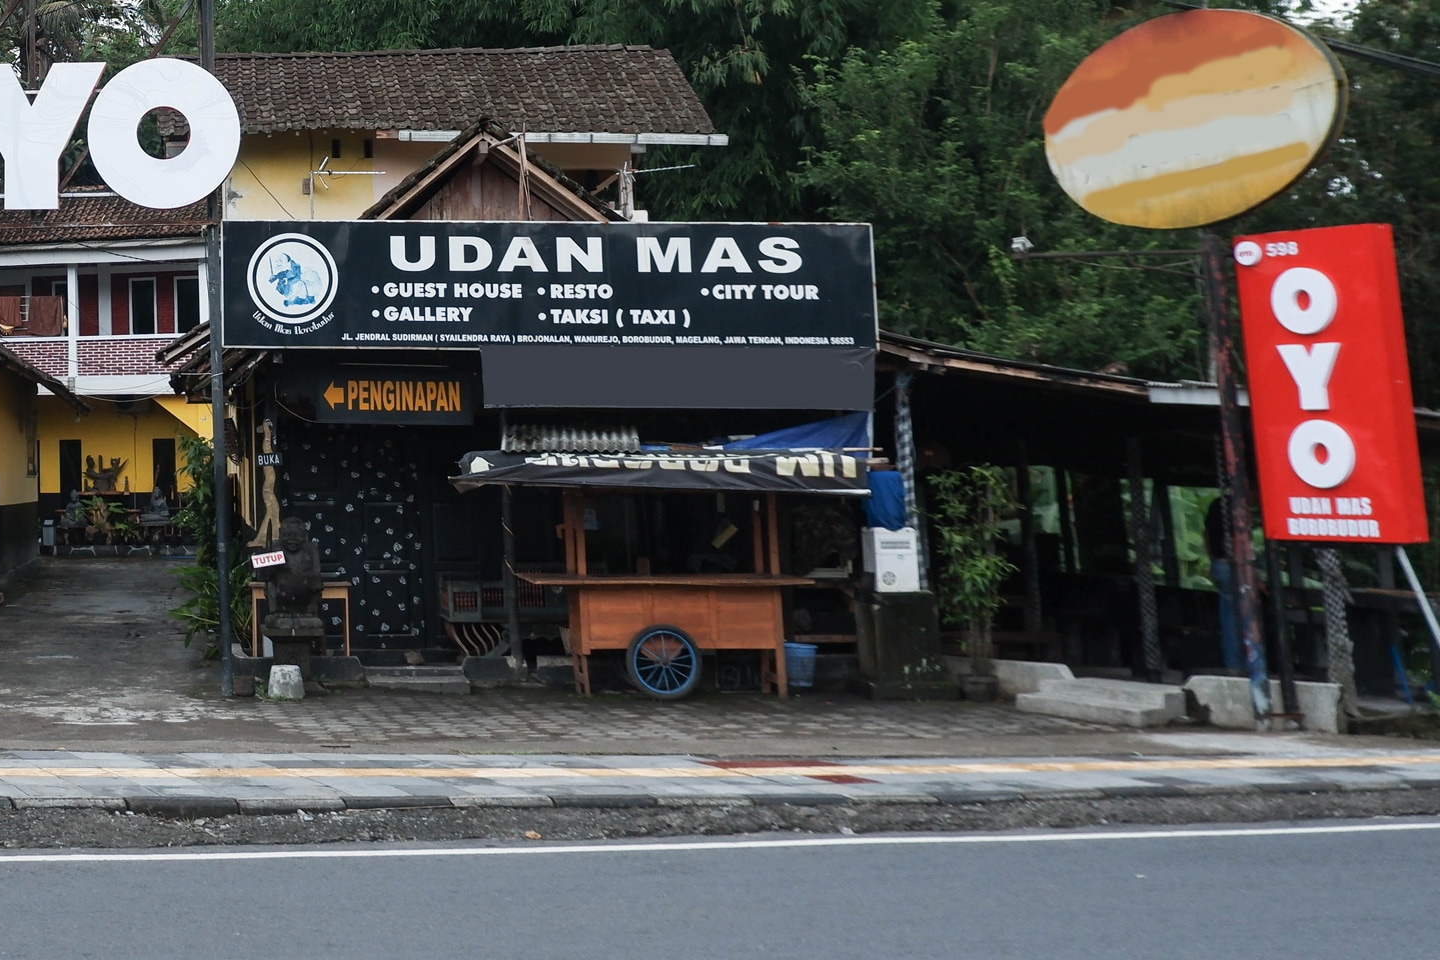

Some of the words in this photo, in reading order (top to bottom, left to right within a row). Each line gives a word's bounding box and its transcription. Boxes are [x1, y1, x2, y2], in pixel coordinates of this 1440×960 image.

[389, 235, 604, 273] UDAN
[636, 236, 803, 274] MAS
[1265, 241, 1299, 258] 598
[382, 282, 448, 299] GUEST
[453, 282, 523, 300] HOUSE
[550, 283, 614, 300] RESTO
[712, 284, 757, 300] CITY
[761, 284, 820, 301] TOUR
[252, 310, 273, 330] Udan
[274, 323, 293, 335] Mas
[294, 311, 336, 336] Borobudur
[383, 306, 474, 323] GALLERY
[550, 308, 609, 325] TAKSI
[629, 309, 676, 325] TAXI
[341, 333, 353, 341] JL.
[355, 333, 391, 342] JENDRAL
[392, 333, 434, 343] SUDIRMAN
[490, 335, 511, 344] RAYA
[517, 335, 573, 345] BROJONALAN,
[574, 335, 621, 345] WANUREJO,
[622, 335, 675, 346] BOROBUDUR,
[675, 336, 723, 346] MAGELANG,
[723, 336, 747, 346] JAWA
[748, 336, 784, 347] TENGAH,
[785, 337, 830, 346] INDONESIA
[1270, 267, 1356, 489] OYO
[347, 380, 462, 413] PENGINAPAN
[257, 454, 280, 466] BUKA
[1288, 496, 1332, 515] UDAN
[1335, 496, 1373, 516] MAS
[1286, 517, 1382, 539] BOROBUDUR
[253, 553, 283, 566] TUTUP
